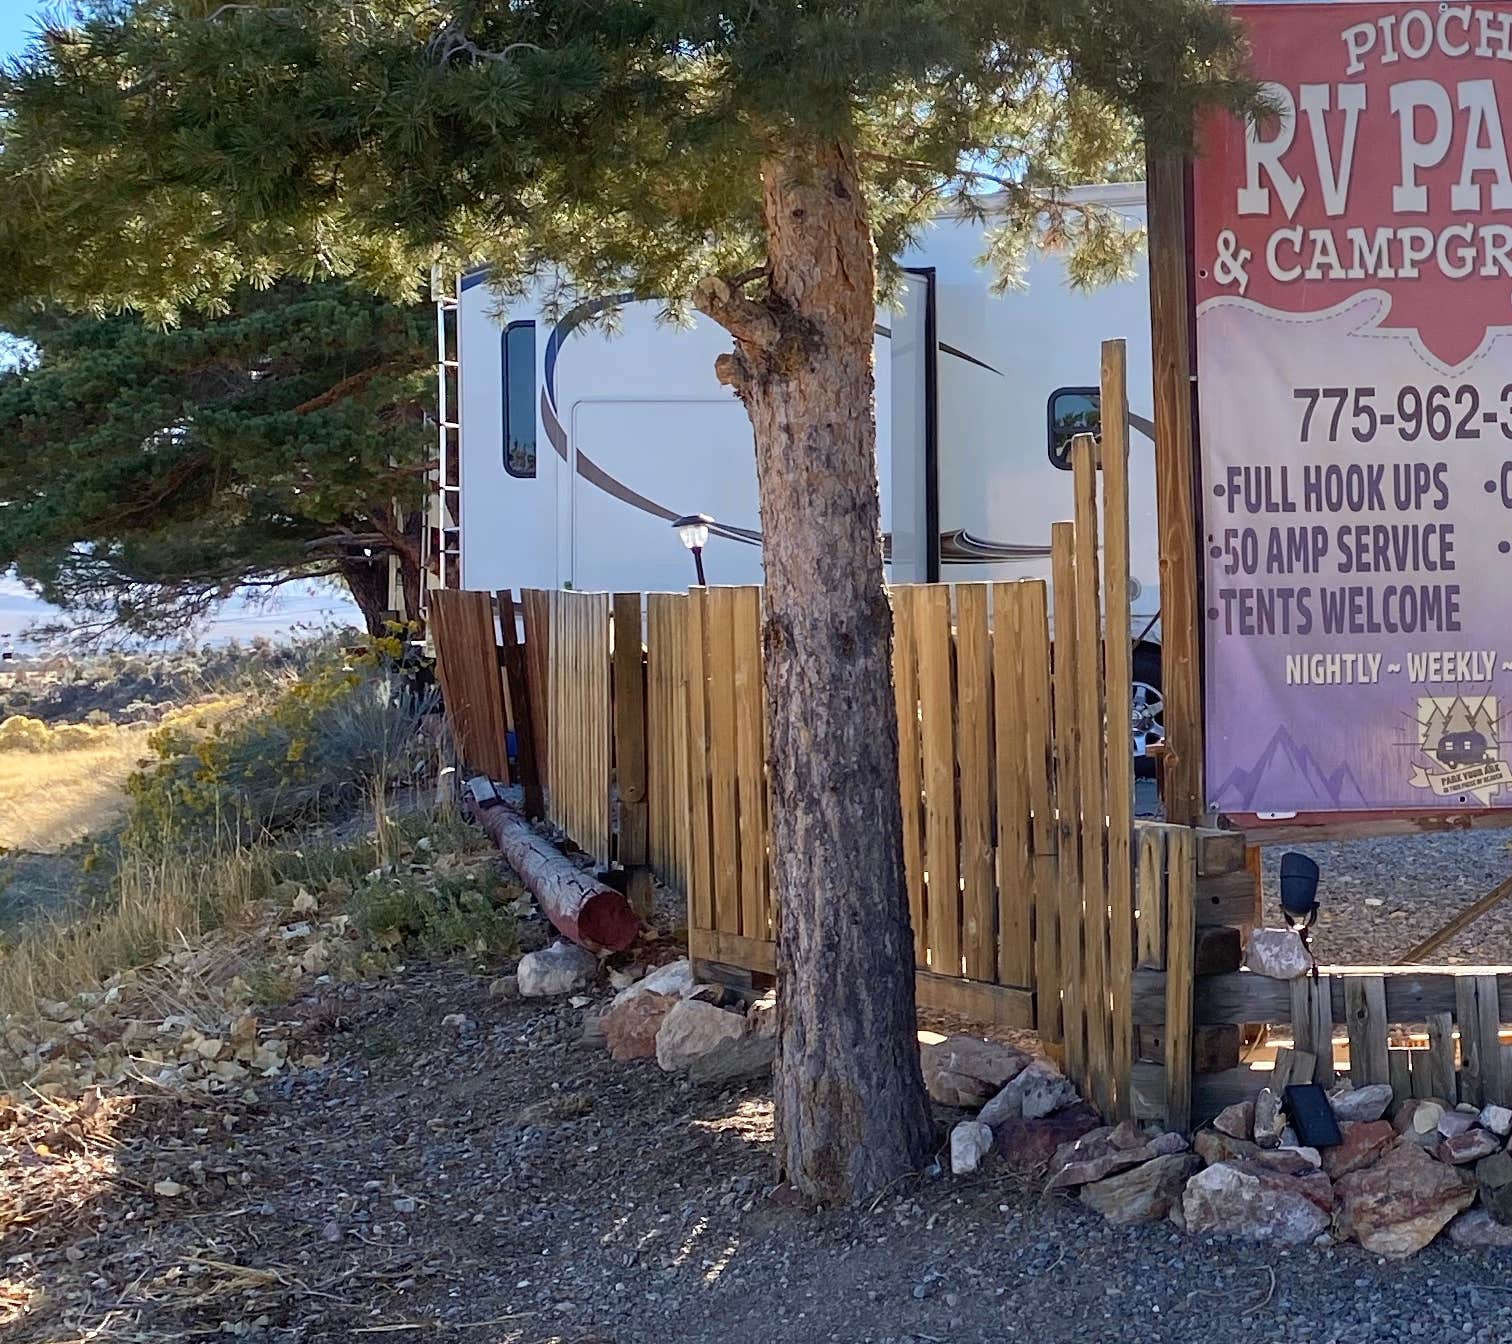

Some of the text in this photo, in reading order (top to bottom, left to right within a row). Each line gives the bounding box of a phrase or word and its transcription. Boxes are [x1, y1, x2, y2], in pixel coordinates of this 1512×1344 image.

[1236, 81, 1367, 221] RV
[1212, 228, 1252, 294] &
[1226, 462, 1450, 514] FULL HOOK UPS
[1224, 523, 1456, 575] 50 AMP SERVICE
[1219, 584, 1462, 636] TENTS WELCOME
[1286, 652, 1384, 686] NIGHTLY
[1406, 650, 1497, 684] WEEKLY
